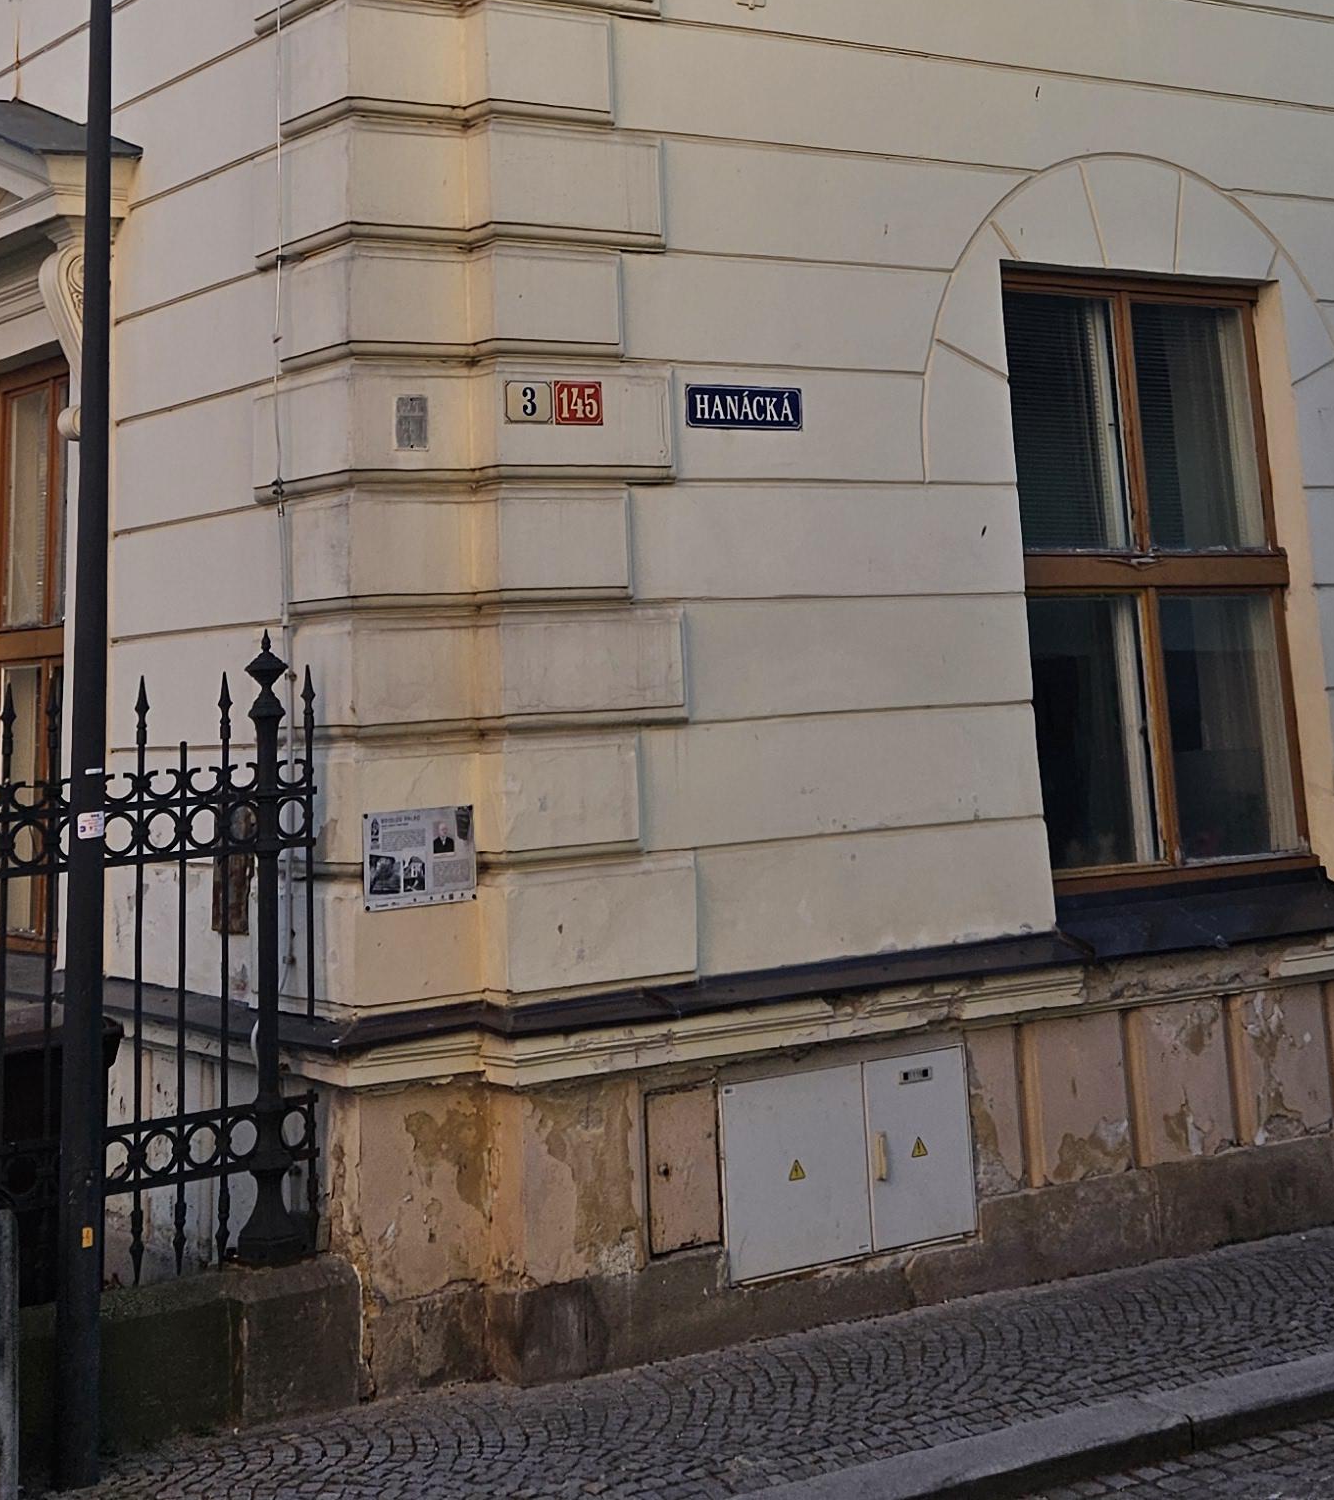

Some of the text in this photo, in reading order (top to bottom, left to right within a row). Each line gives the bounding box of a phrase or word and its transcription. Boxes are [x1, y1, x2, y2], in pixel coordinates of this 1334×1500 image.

[522, 387, 537, 417] 3
[559, 387, 599, 419] 145
[694, 390, 794, 422] HANÁCKÁ
